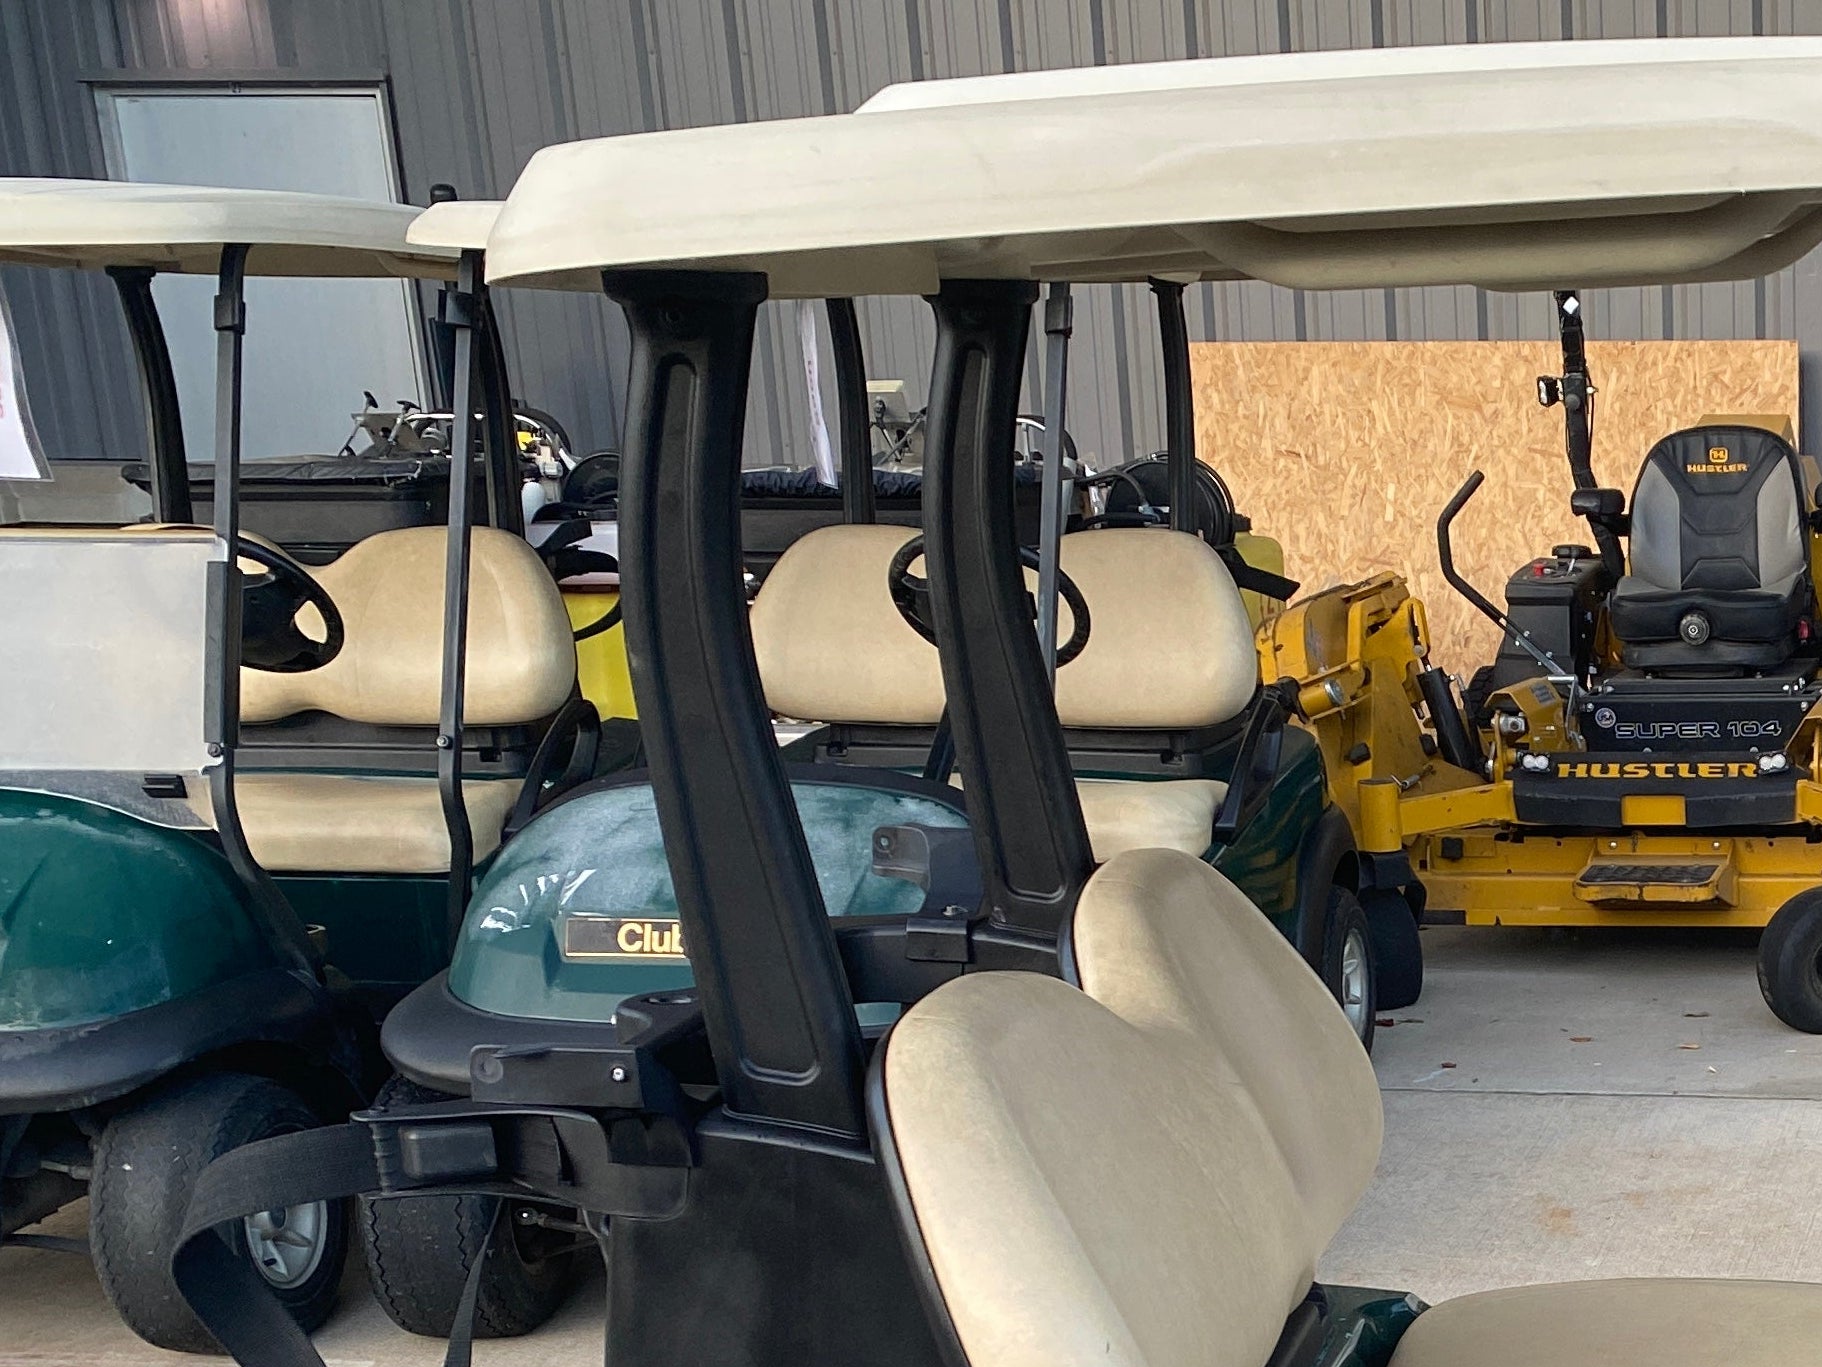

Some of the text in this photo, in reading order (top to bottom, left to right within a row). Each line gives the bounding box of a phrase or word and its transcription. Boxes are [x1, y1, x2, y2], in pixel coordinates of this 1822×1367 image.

[1687, 463, 1748, 473] HUSTLER
[1615, 720, 1782, 739] SUPER 104
[1557, 762, 1758, 779] HUSTLER
